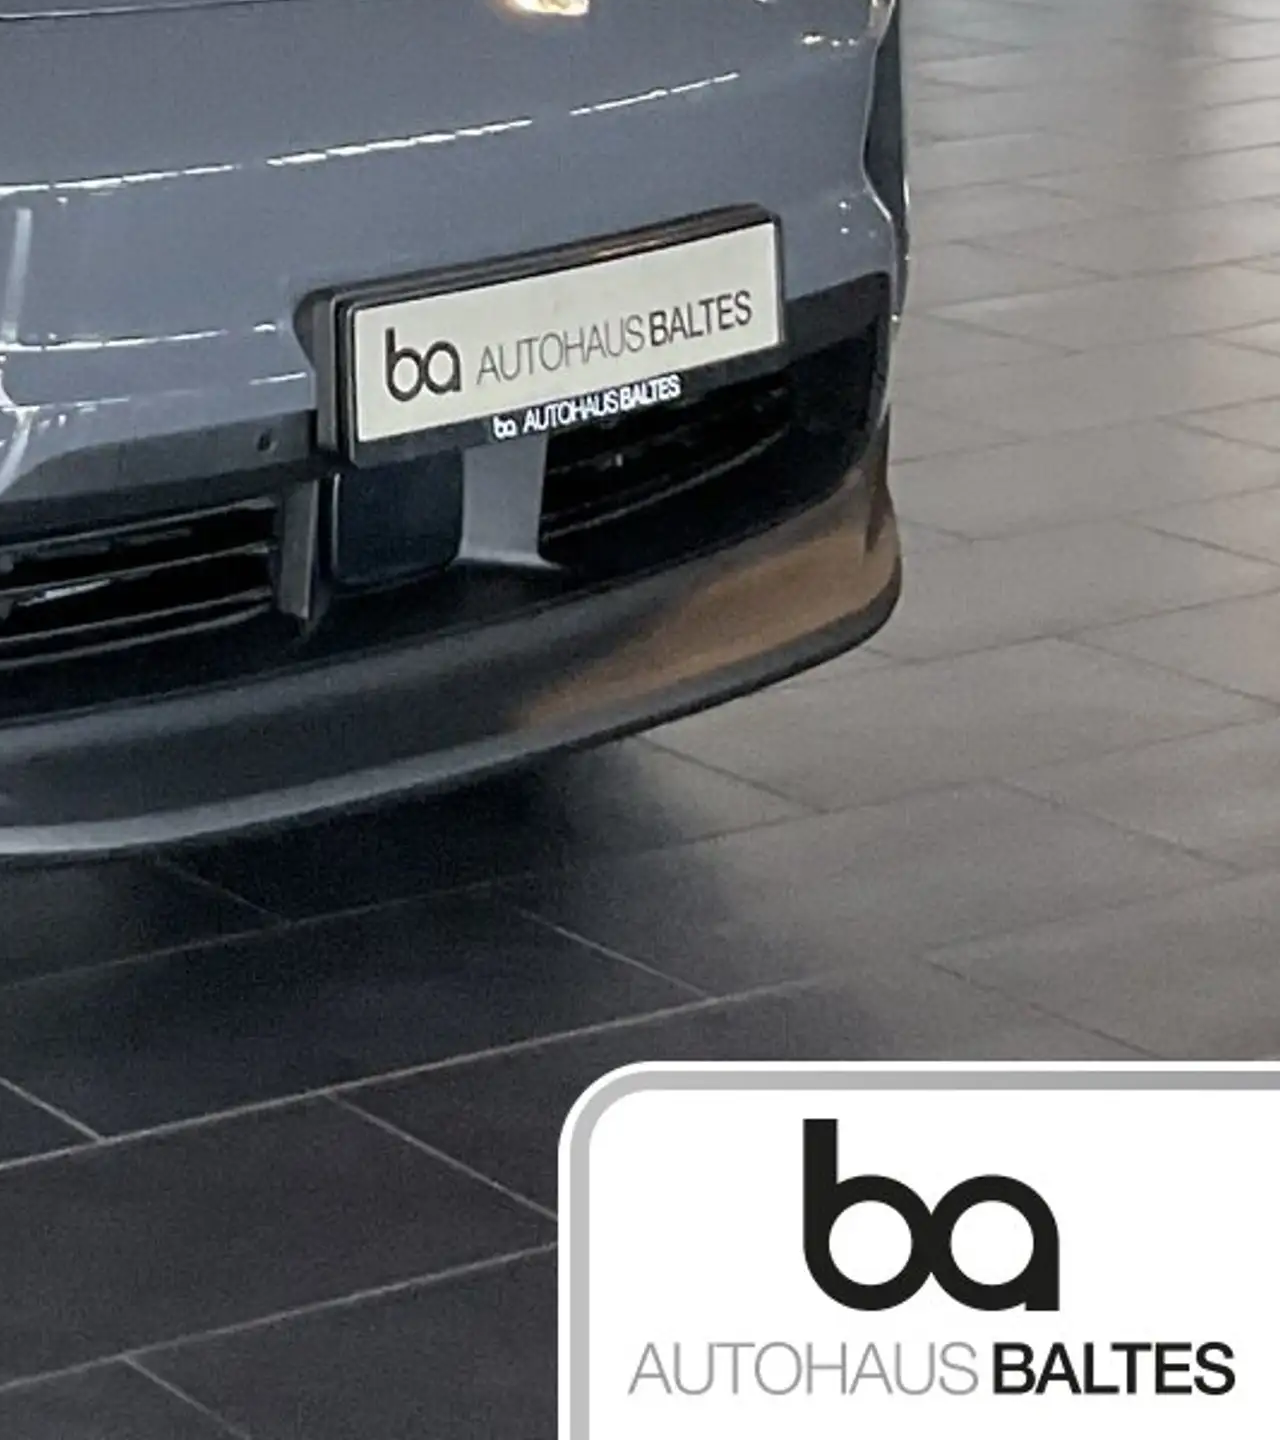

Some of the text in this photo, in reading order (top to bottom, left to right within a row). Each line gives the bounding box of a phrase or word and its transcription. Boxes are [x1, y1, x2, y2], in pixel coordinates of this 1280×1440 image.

[385, 290, 752, 402] ba AUTOHAUS BALTES
[493, 374, 681, 439] ba AUTOHAUS BALTES
